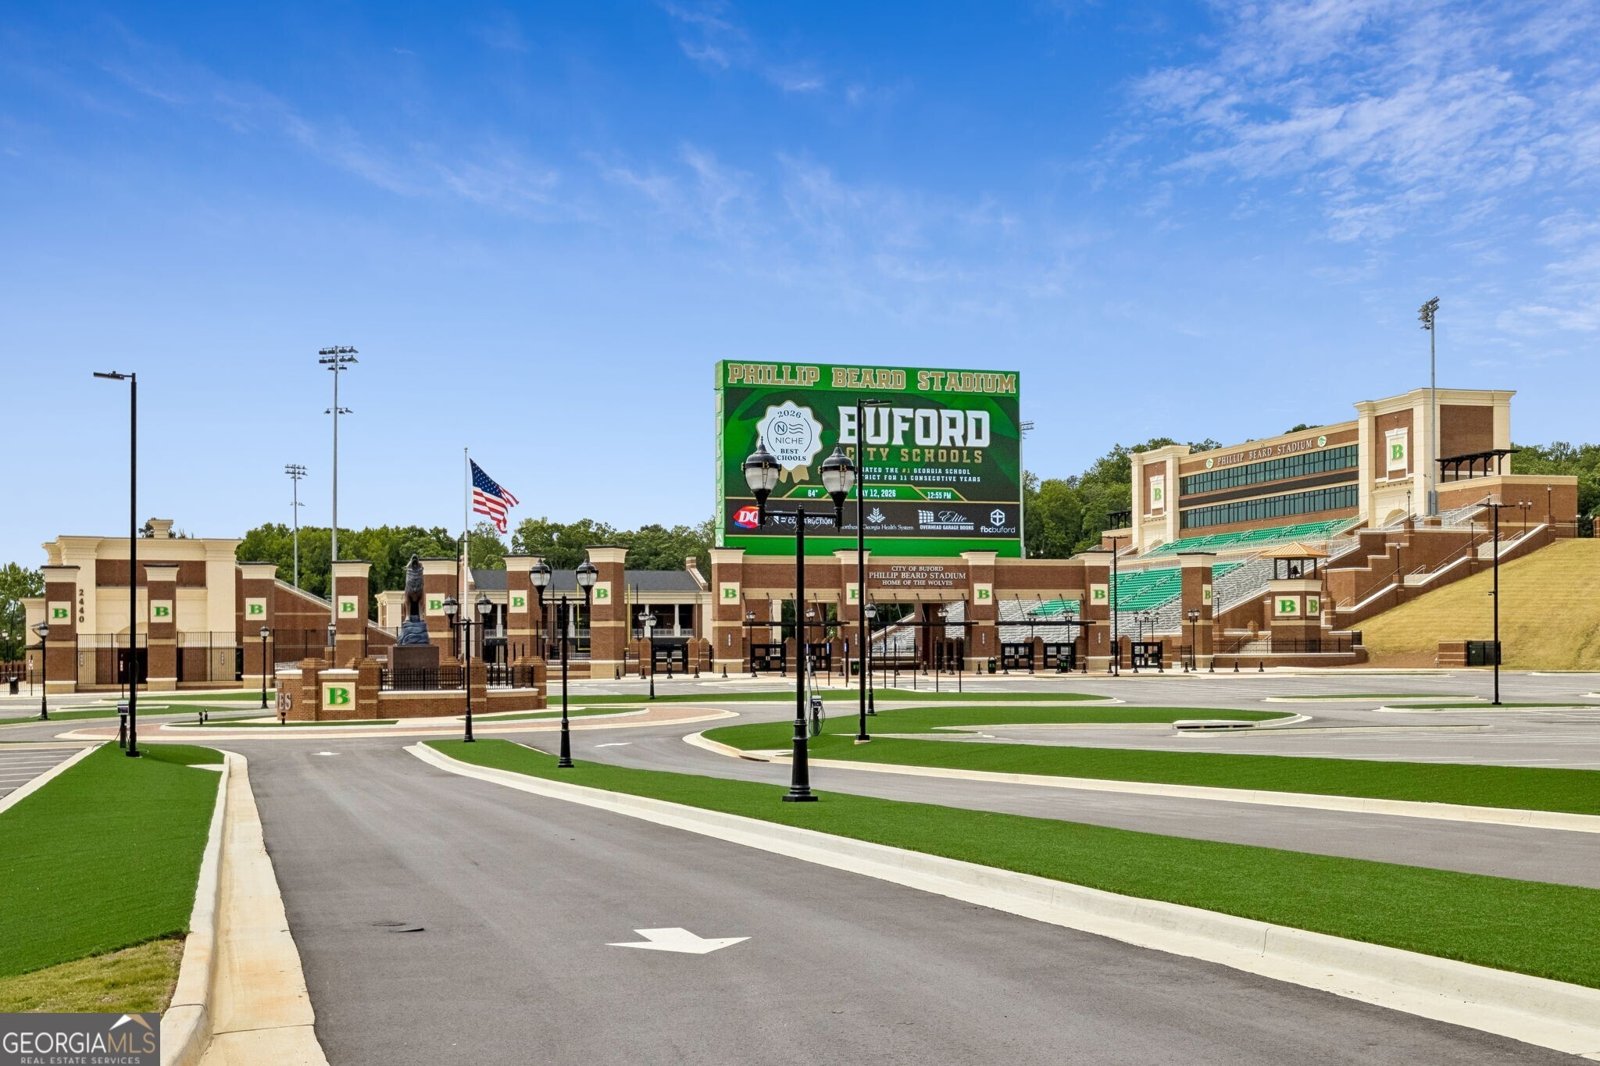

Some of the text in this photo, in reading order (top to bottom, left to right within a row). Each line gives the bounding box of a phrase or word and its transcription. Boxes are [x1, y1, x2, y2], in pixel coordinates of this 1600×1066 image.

[728, 363, 1016, 393] PHILLIP BEARD STADIUM
[778, 410, 802, 418] 2026
[777, 424, 785, 432] N
[838, 406, 990, 447] BUFORD
[846, 447, 983, 464] CTY SCHOOLS
[1217, 440, 1313, 466] PHILLIP BEARD STADIUM
[1392, 444, 1403, 460] B
[870, 489, 880, 498] 12,
[881, 489, 897, 498] 2026
[927, 491, 943, 499] 12:55
[1154, 488, 1162, 501] B
[739, 510, 759, 523] DQ
[938, 510, 967, 522] Elite
[596, 588, 609, 599] B
[723, 588, 737, 598] B
[977, 589, 990, 599] B
[1094, 589, 1106, 599] B
[1204, 590, 1211, 600] B
[341, 602, 355, 612] B
[429, 600, 442, 610] B
[513, 597, 525, 607] B
[1280, 599, 1296, 613] B
[1308, 599, 1318, 613] B
[53, 608, 68, 618] B
[154, 606, 169, 617] B
[249, 604, 263, 614] B
[327, 687, 350, 705] B
